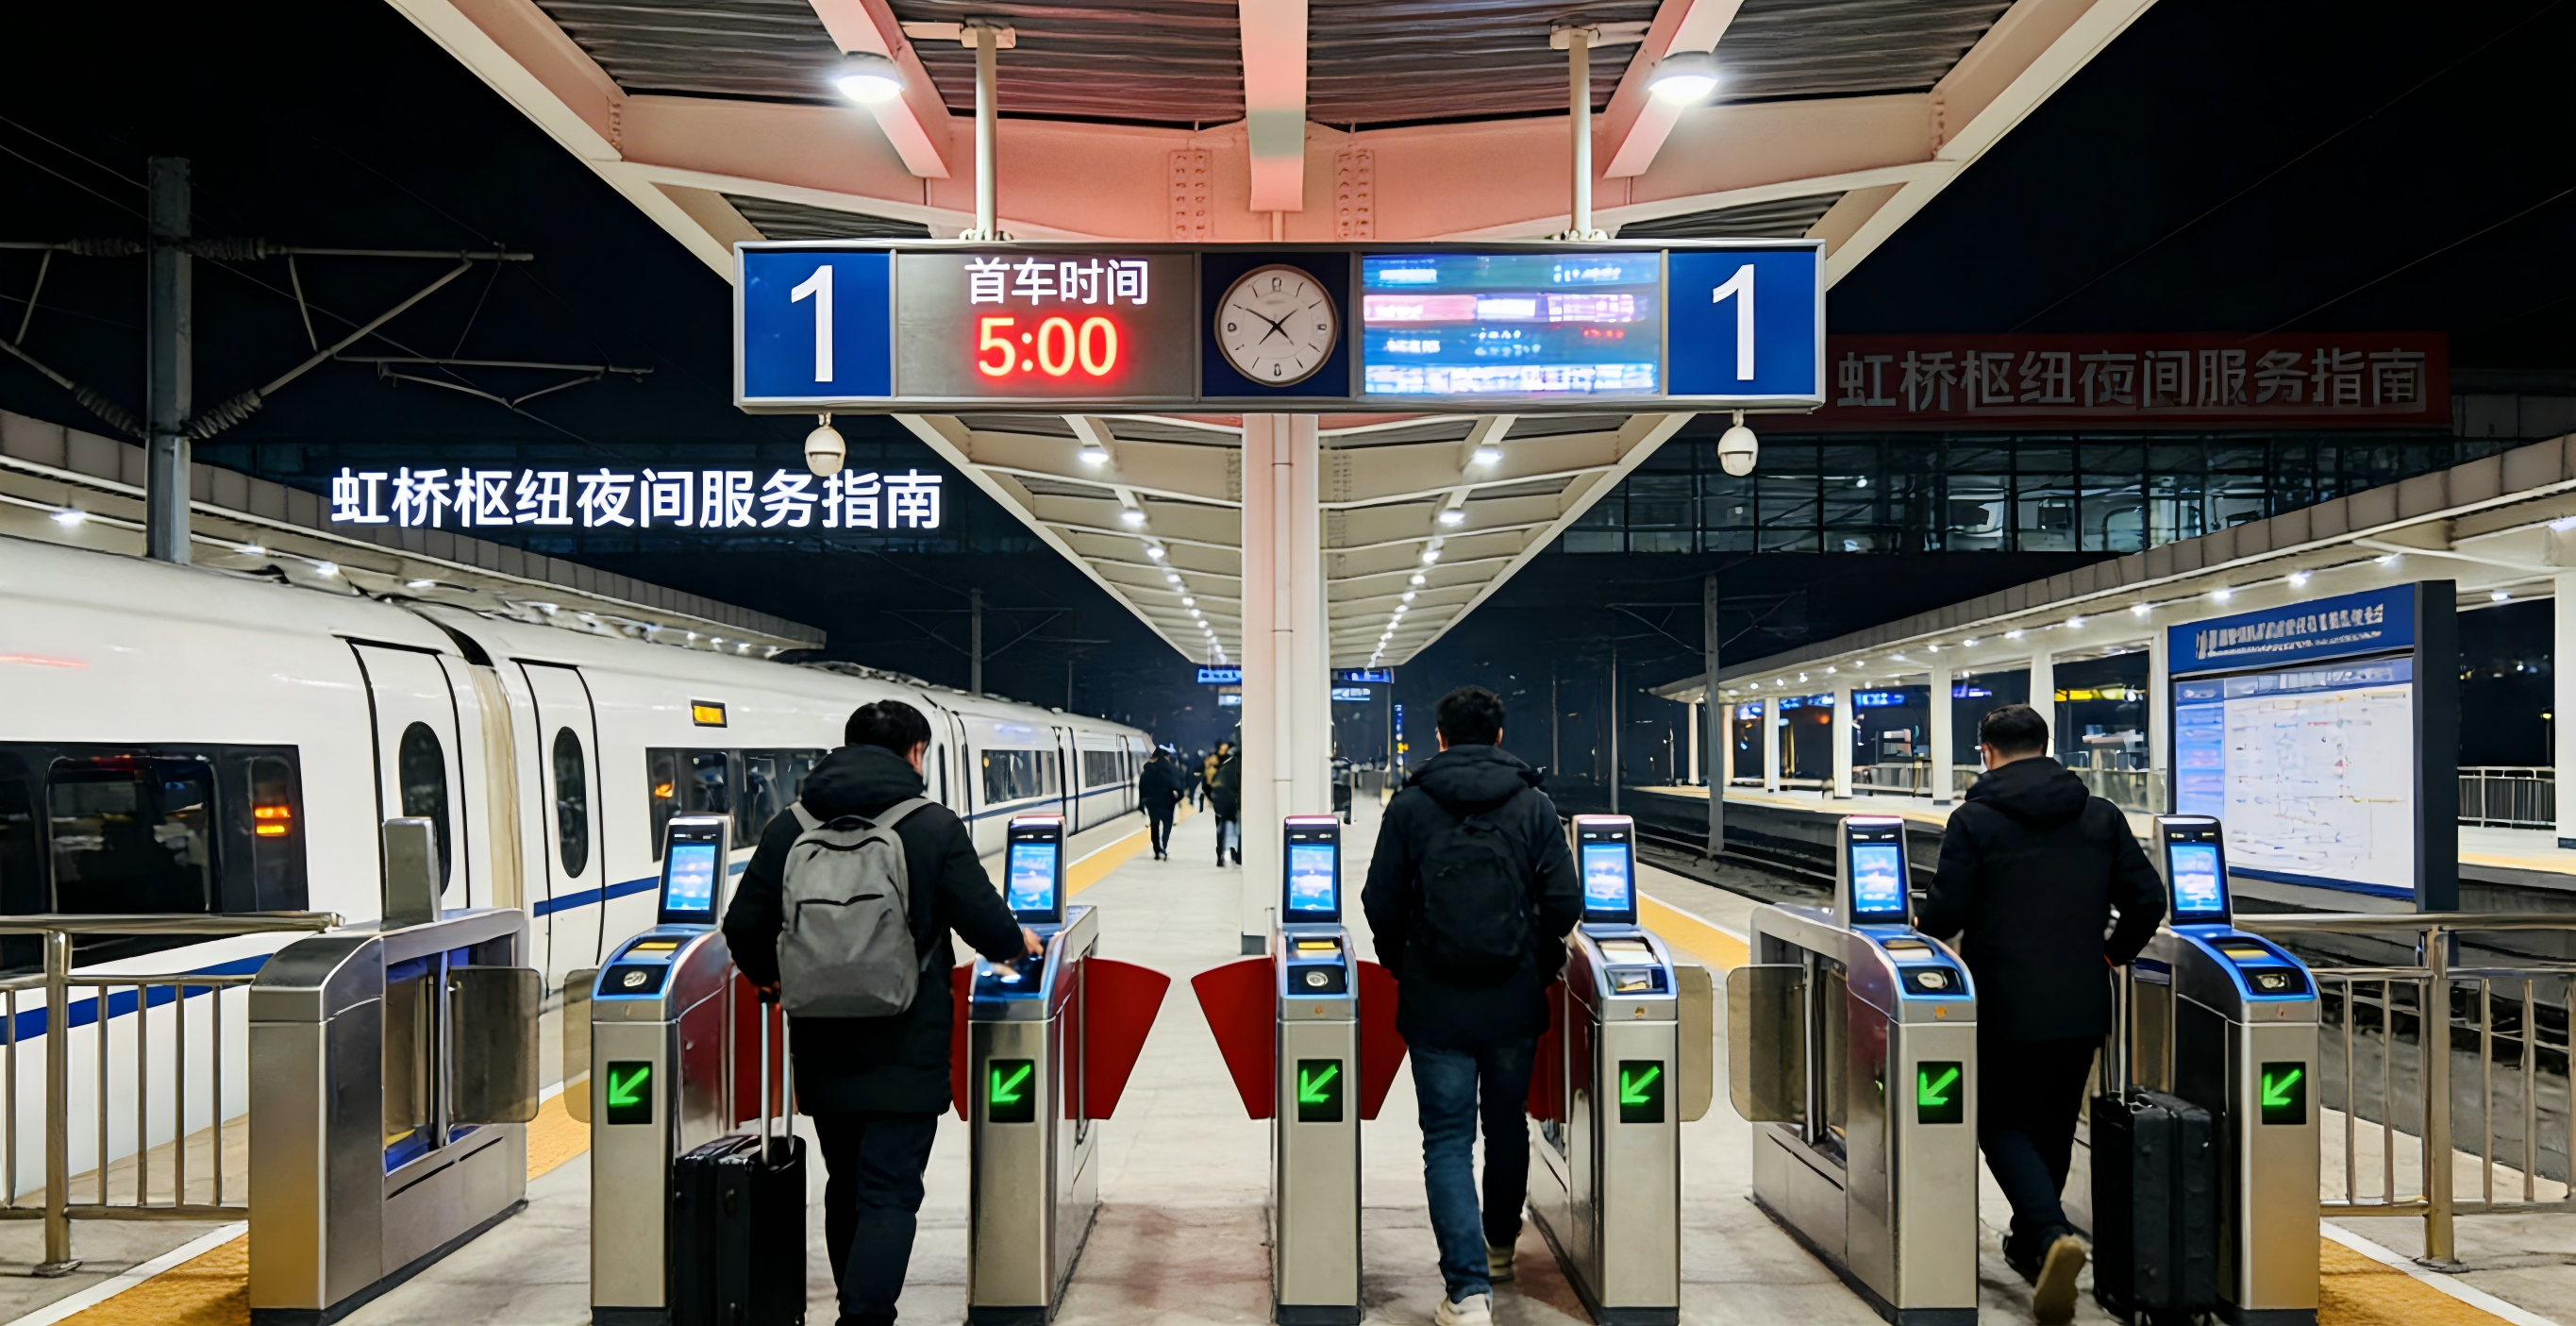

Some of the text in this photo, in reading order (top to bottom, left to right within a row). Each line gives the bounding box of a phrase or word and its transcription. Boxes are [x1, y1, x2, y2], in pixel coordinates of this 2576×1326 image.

[964, 258, 1148, 305] 首车时间
[791, 265, 833, 382] 1
[978, 316, 1118, 377] 5:00
[1713, 264, 1754, 380] 1
[330, 467, 943, 529] 虹桥枢纽夜间服务指南
